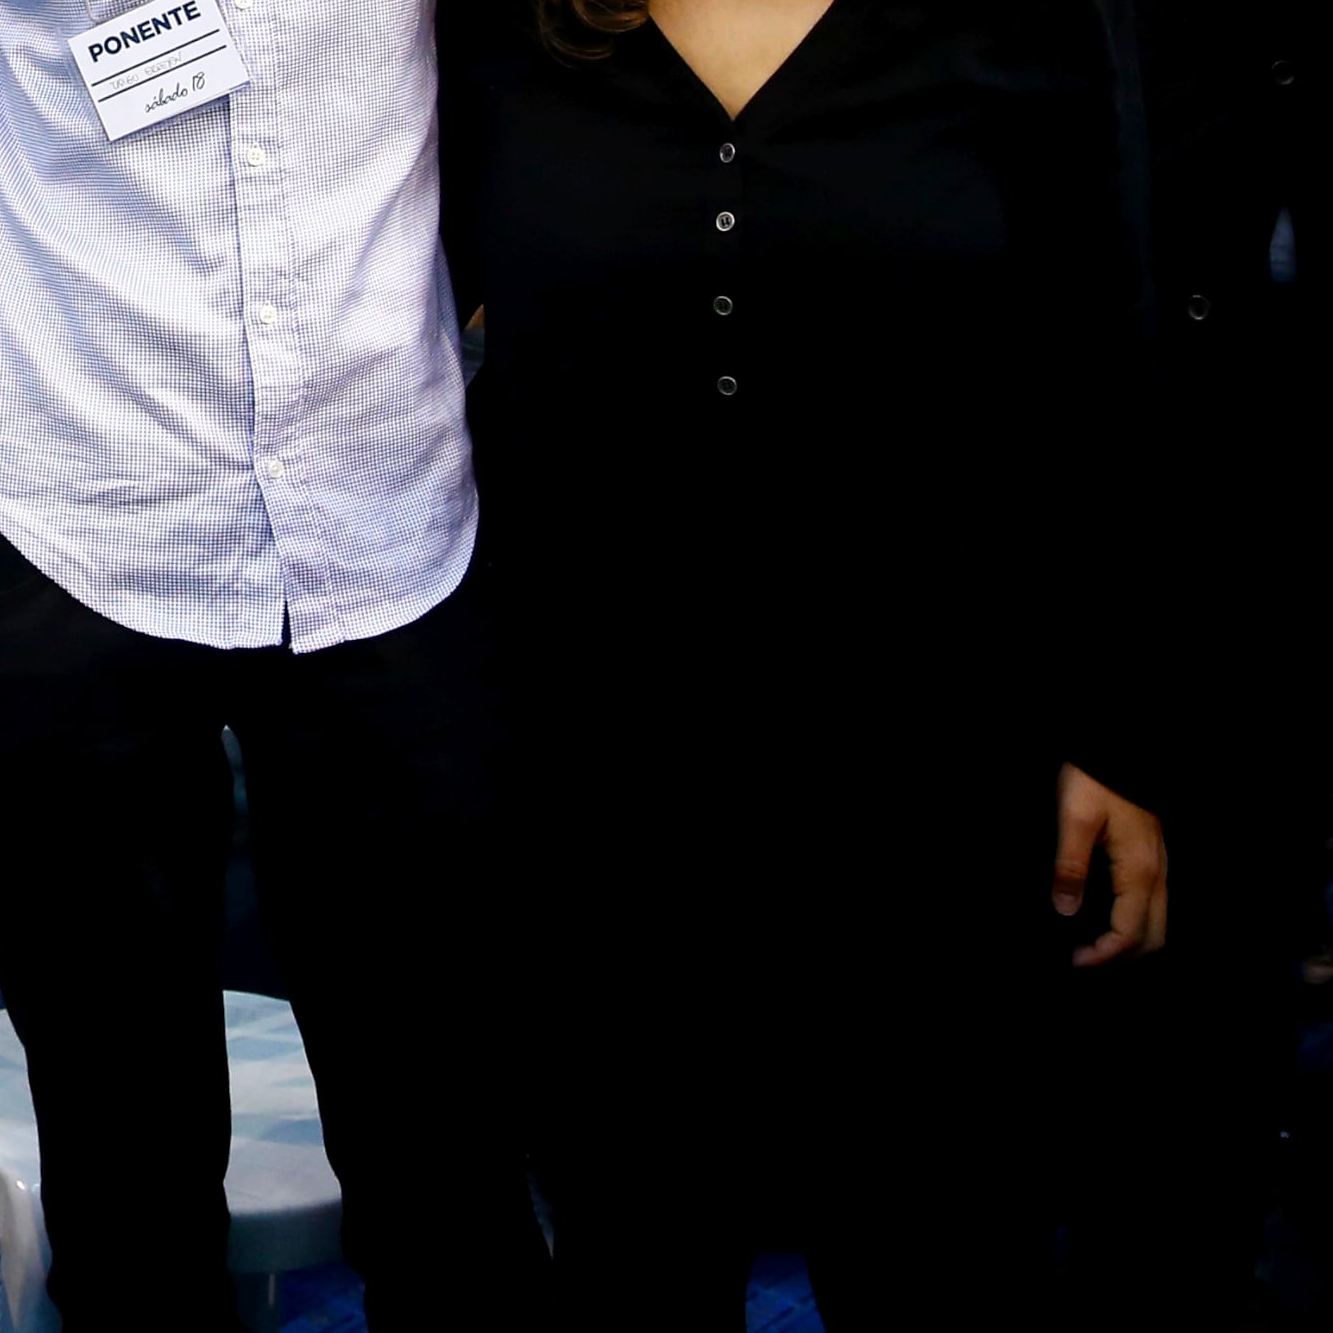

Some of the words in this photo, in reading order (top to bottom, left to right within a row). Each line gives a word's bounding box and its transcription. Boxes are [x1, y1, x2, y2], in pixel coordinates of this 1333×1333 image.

[88, 0, 201, 63] PONENTE
[144, 82, 188, 114] sábado
[192, 71, 206, 92] 18
